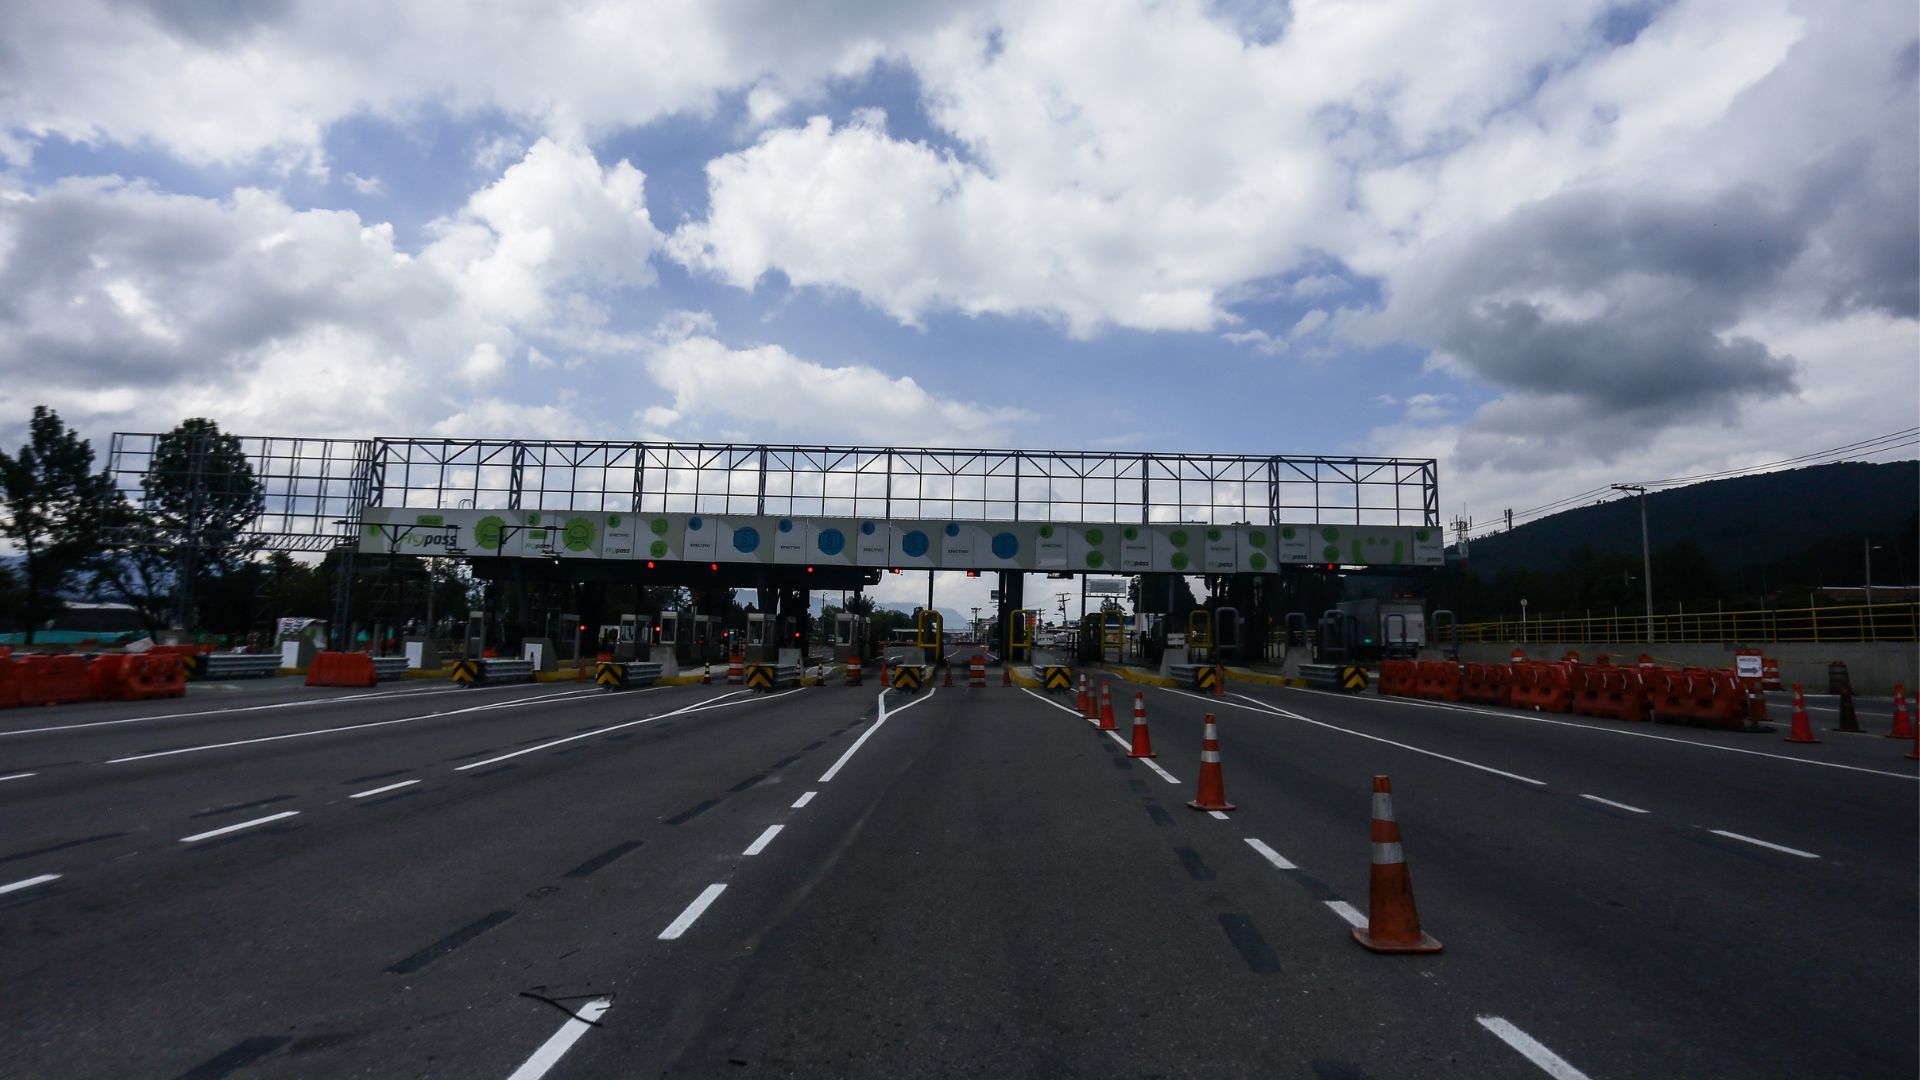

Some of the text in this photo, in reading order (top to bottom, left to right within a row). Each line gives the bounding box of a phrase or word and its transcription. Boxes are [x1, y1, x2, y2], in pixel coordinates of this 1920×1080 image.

[528, 514, 536, 525] 2
[400, 532, 458, 547] Flypass
[1208, 531, 1219, 539] 10
